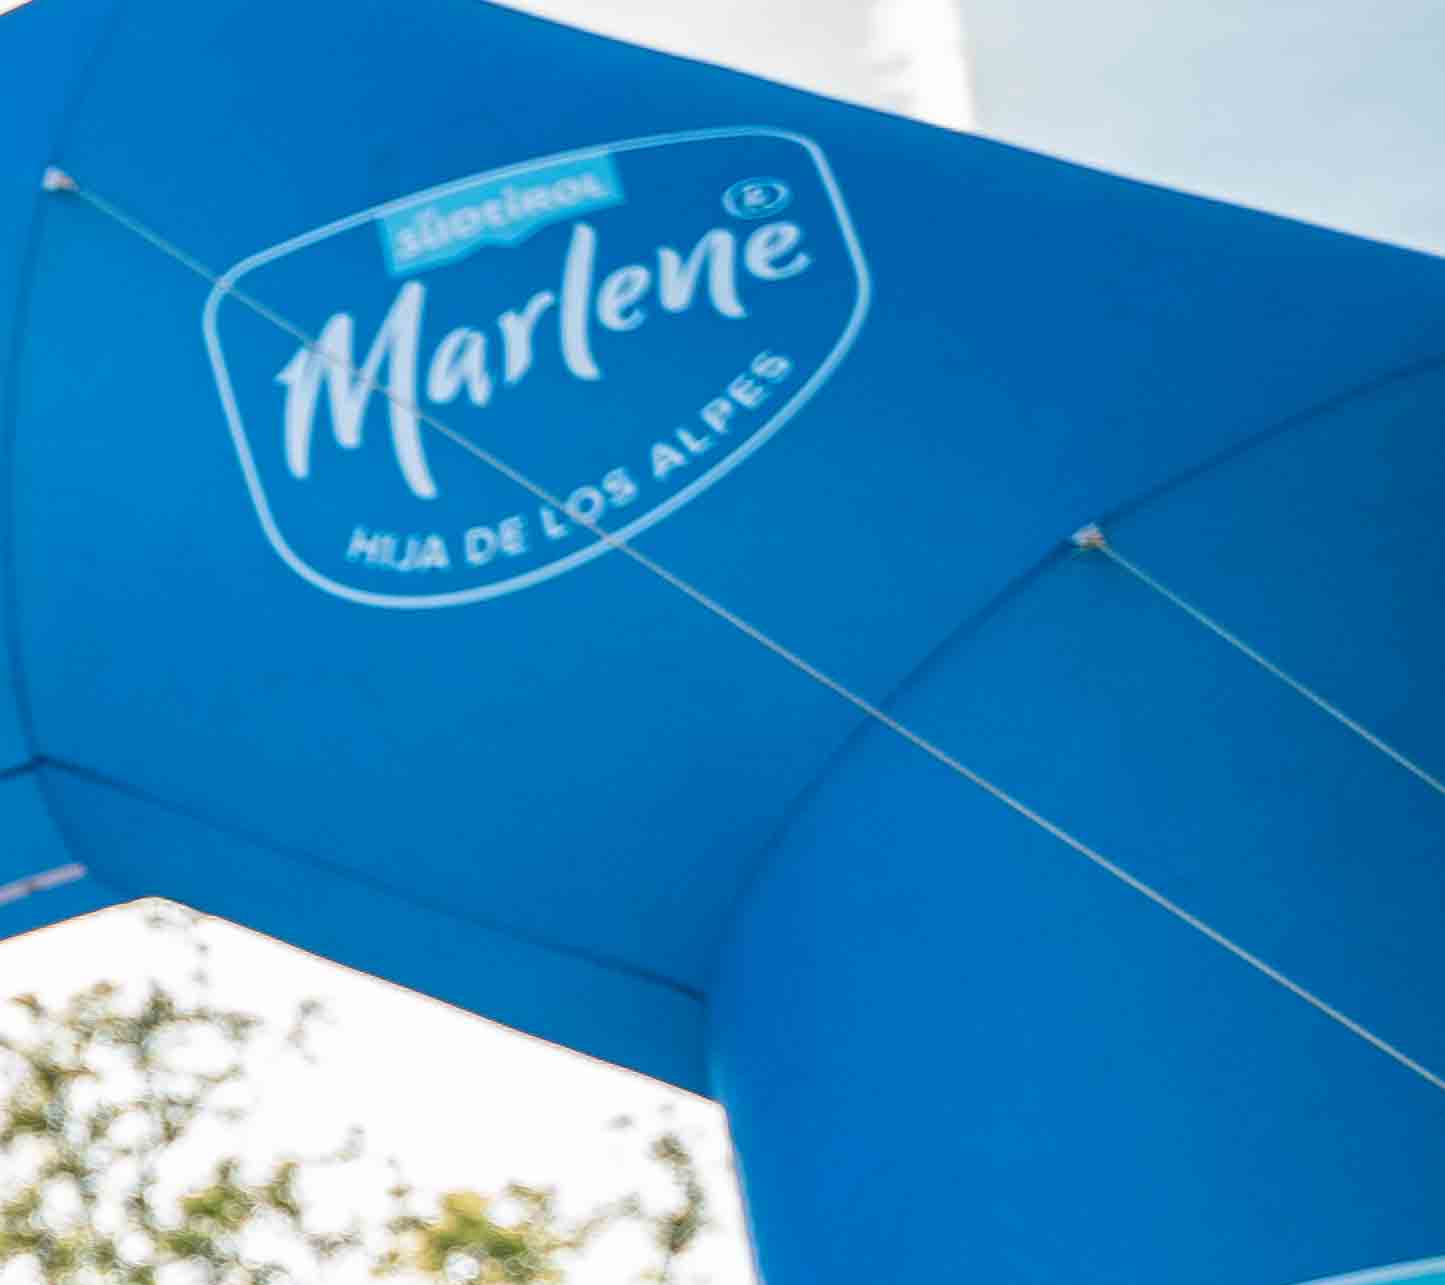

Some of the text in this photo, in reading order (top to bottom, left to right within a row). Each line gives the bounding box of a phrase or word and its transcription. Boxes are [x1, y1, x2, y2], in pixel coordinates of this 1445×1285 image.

[275, 213, 811, 498] Marlene
[345, 349, 794, 572] HIJA DE LOS ALPES
